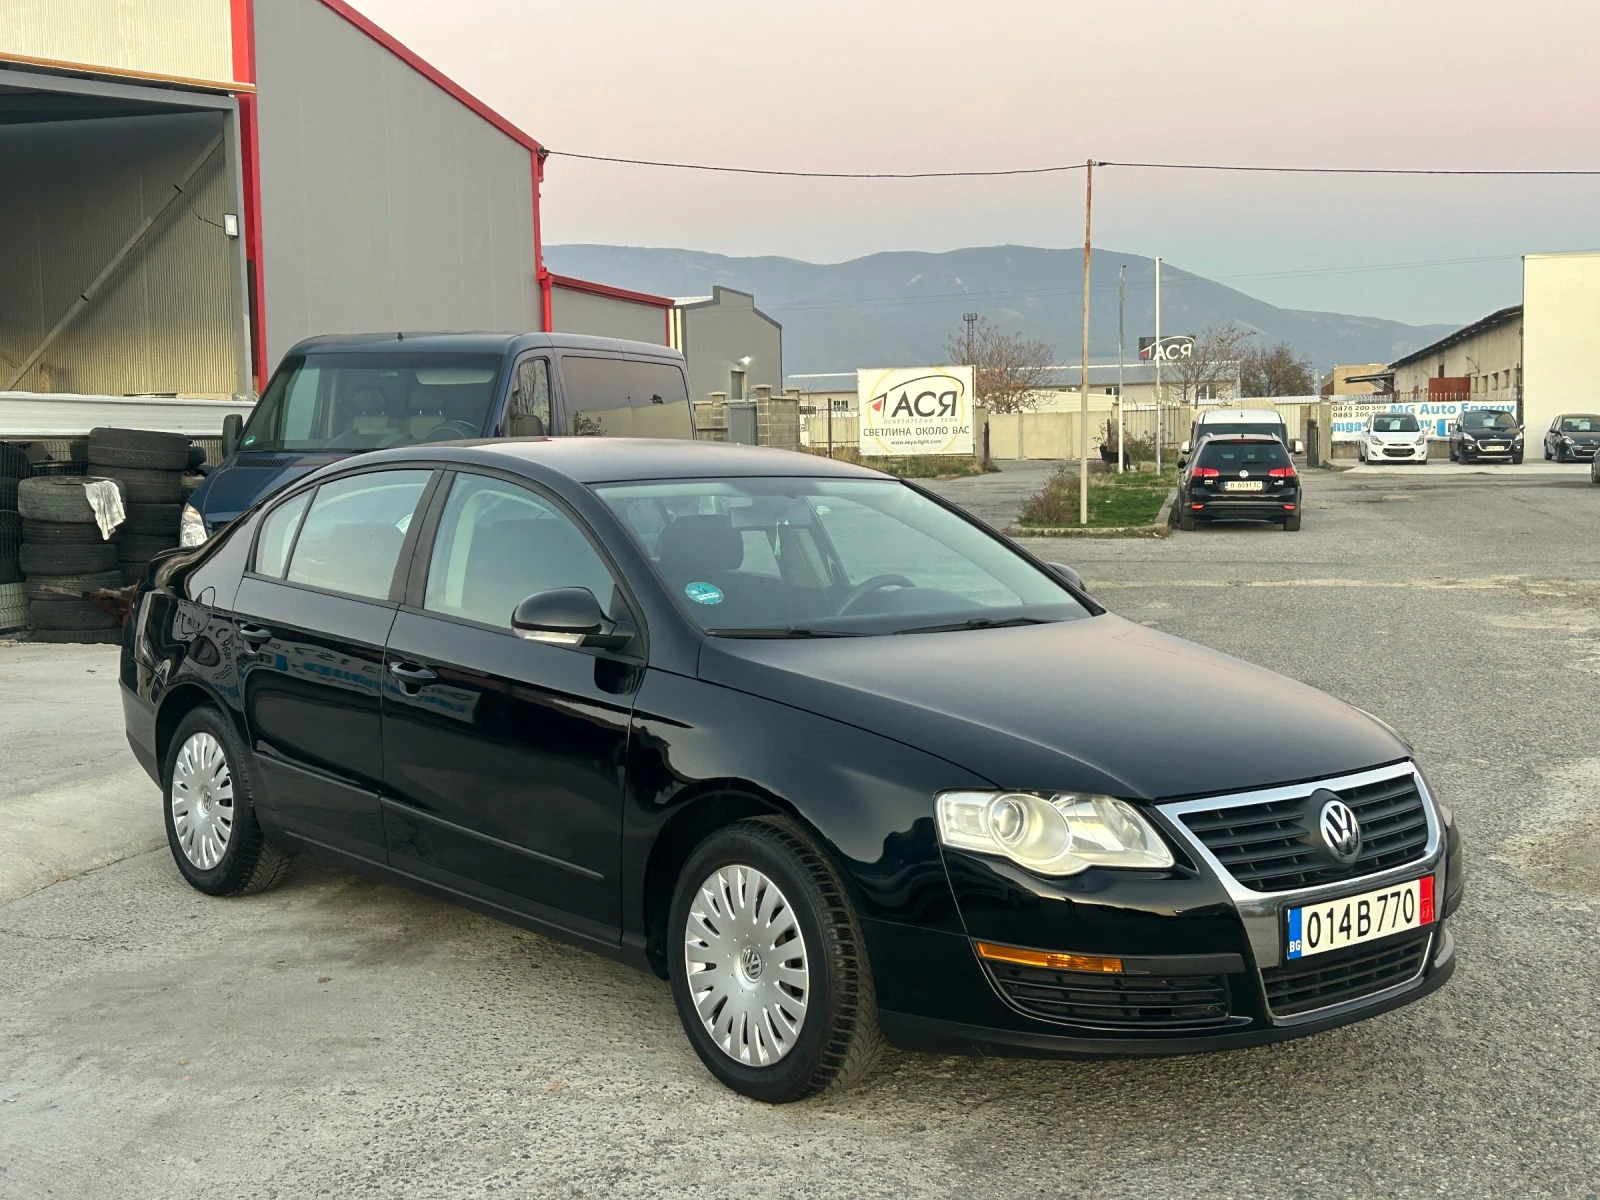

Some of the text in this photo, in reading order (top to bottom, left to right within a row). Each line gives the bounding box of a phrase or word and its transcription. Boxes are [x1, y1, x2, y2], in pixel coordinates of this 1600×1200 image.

[890, 390, 957, 418] АСЯ
[1390, 404, 1415, 415] MG
[1420, 403, 1457, 415] Auto
[863, 425, 970, 437] СВЕТЛИНА ОКОЛО ВАС
[1306, 888, 1415, 949] 014B770
[1289, 939, 1301, 953] BG
